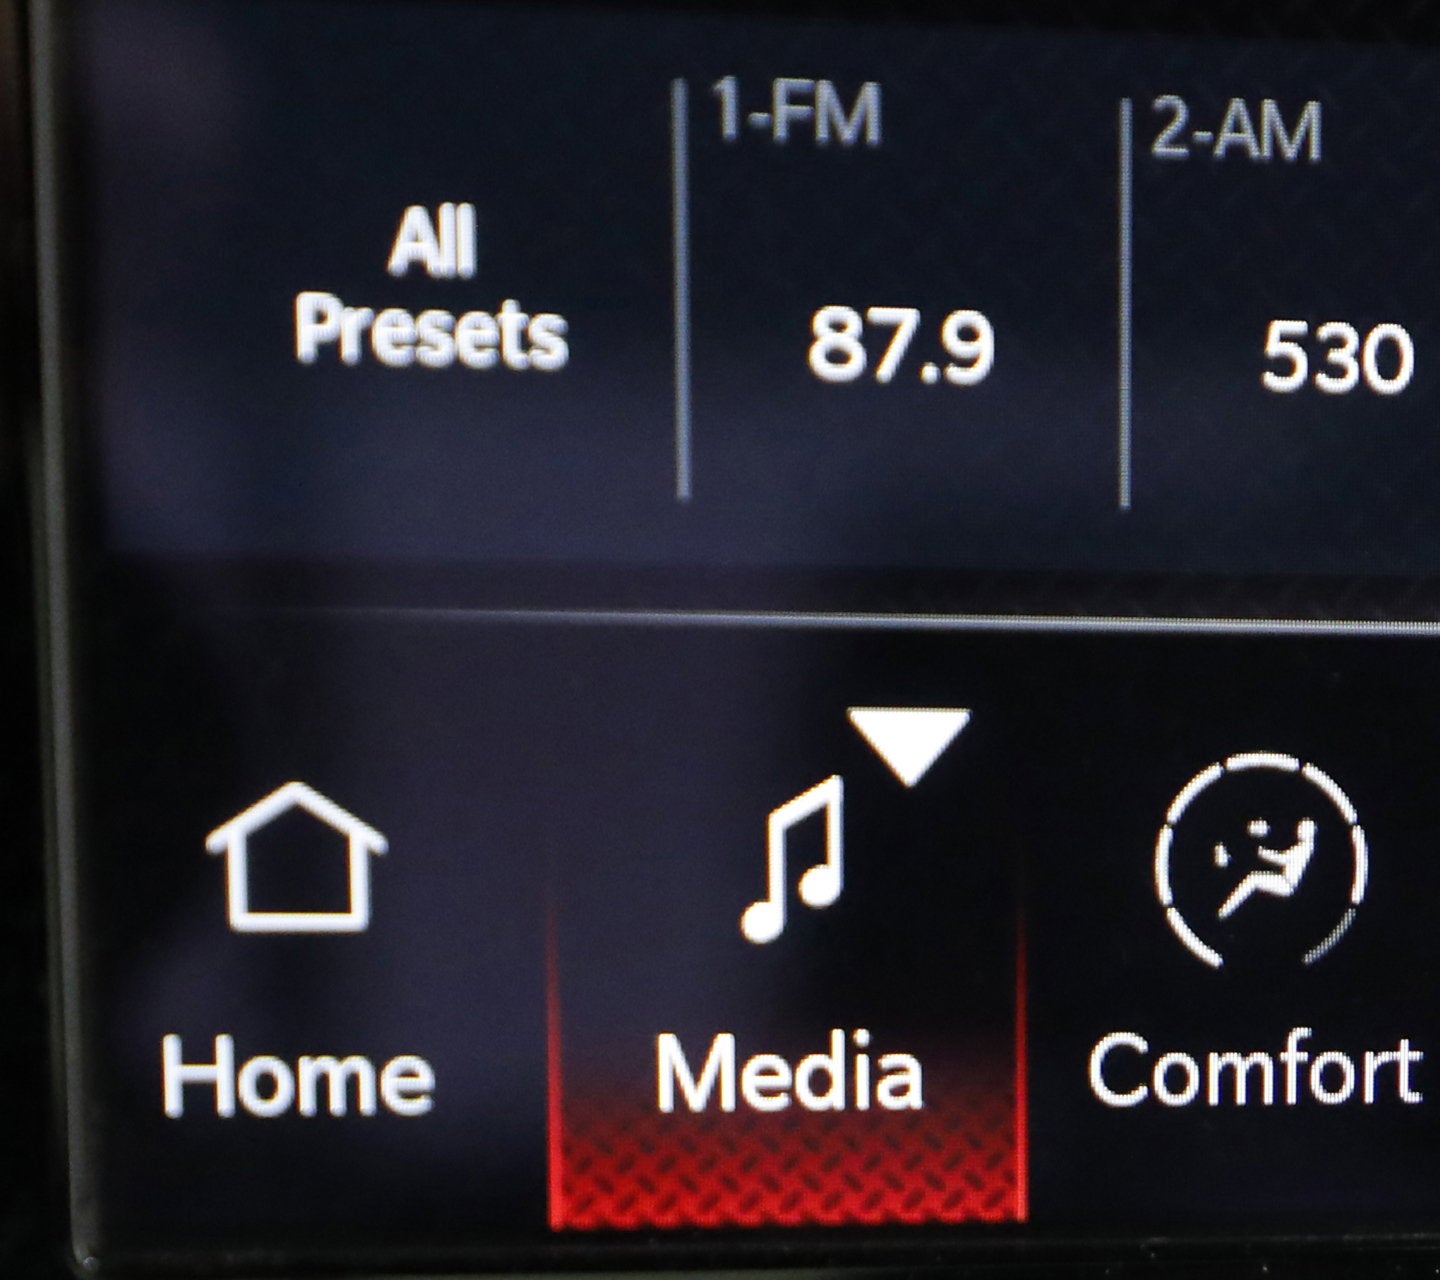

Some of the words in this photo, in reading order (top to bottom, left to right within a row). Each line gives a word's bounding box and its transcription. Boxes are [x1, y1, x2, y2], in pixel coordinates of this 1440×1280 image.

[715, 76, 880, 144] 1-FM
[1152, 95, 1320, 161] 2-AM
[388, 203, 475, 276] All
[296, 292, 568, 370] Presets
[809, 306, 994, 384] 87.9
[1263, 320, 1414, 394] 530
[163, 1034, 435, 1117] Home
[657, 1029, 923, 1112] Media
[1089, 1027, 1422, 1106] Comfort
